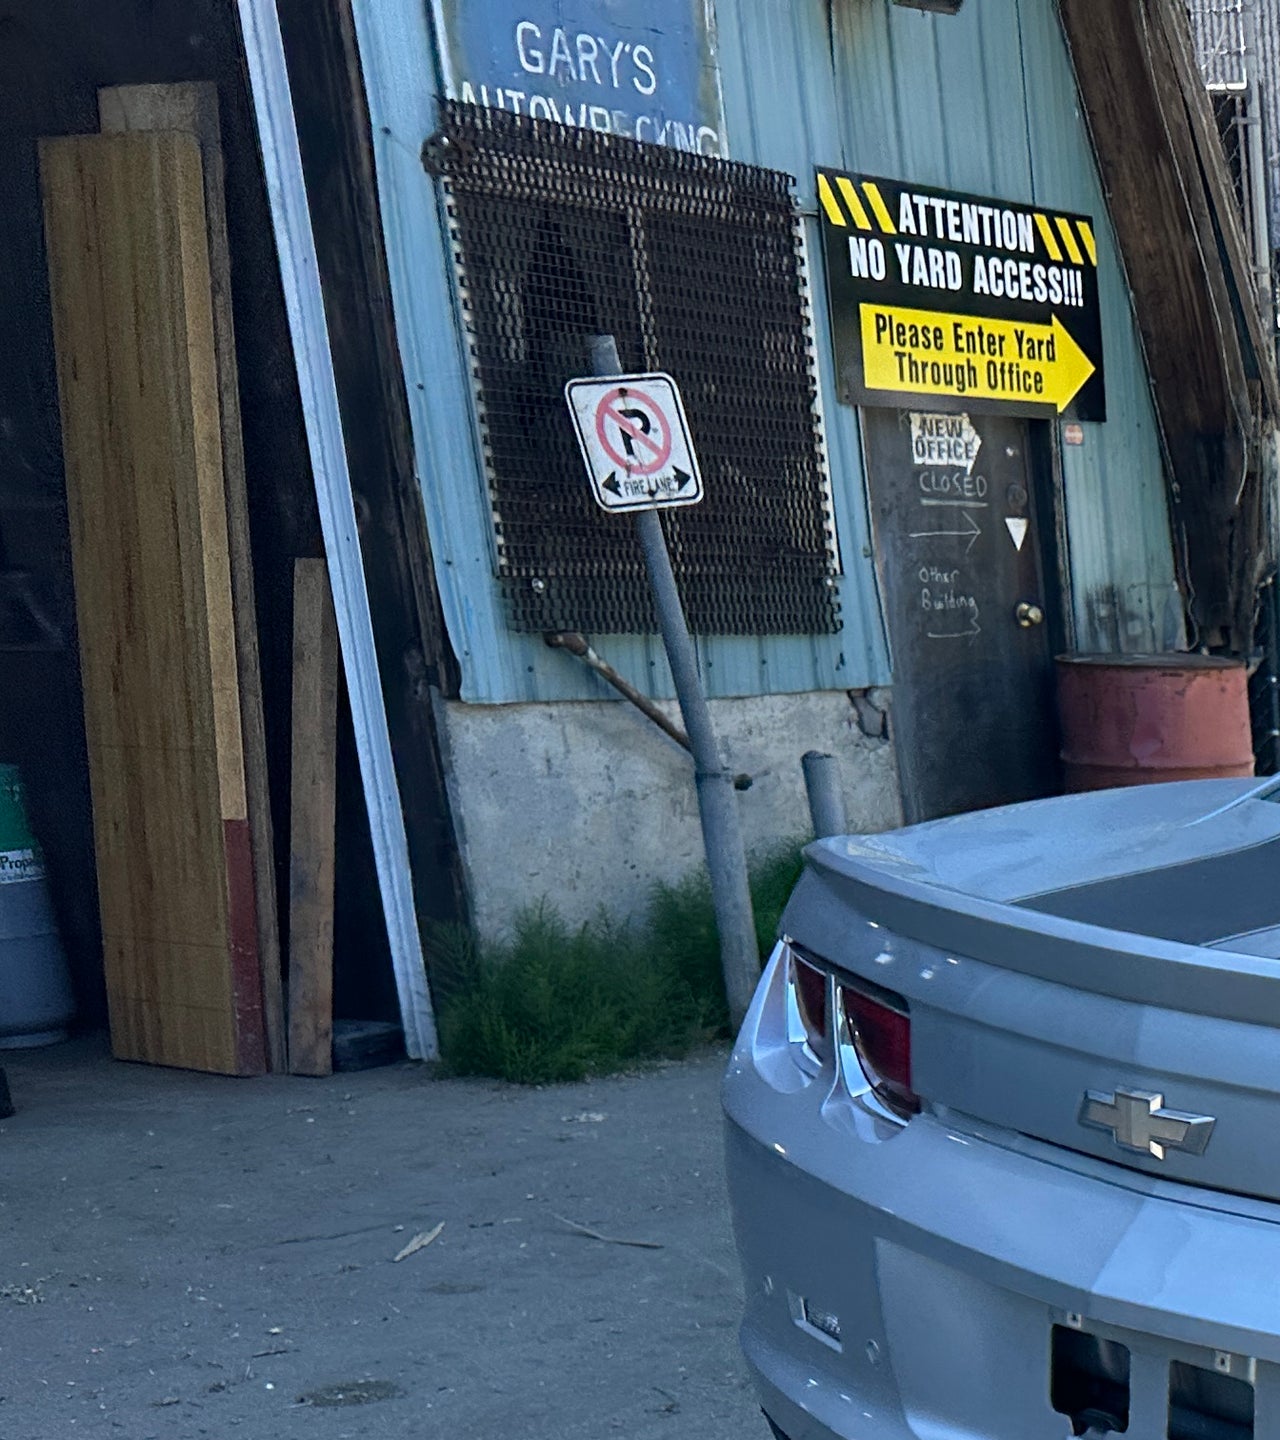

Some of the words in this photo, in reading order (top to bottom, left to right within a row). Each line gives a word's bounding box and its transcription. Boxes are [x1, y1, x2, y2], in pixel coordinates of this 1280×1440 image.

[515, 21, 657, 95] GARY'S
[899, 192, 1035, 253] ATTENTION
[849, 236, 886, 281] NO
[895, 243, 962, 291] YARD
[973, 255, 1084, 307] ACCESS!!!
[875, 313, 944, 351] Please
[953, 322, 1006, 357] Enter
[1014, 331, 1056, 362] Yard
[894, 351, 978, 393] Through
[987, 359, 1044, 394] Office
[916, 437, 975, 459] OFFICE
[919, 416, 963, 437] NEW
[920, 471, 987, 497] CLOSED
